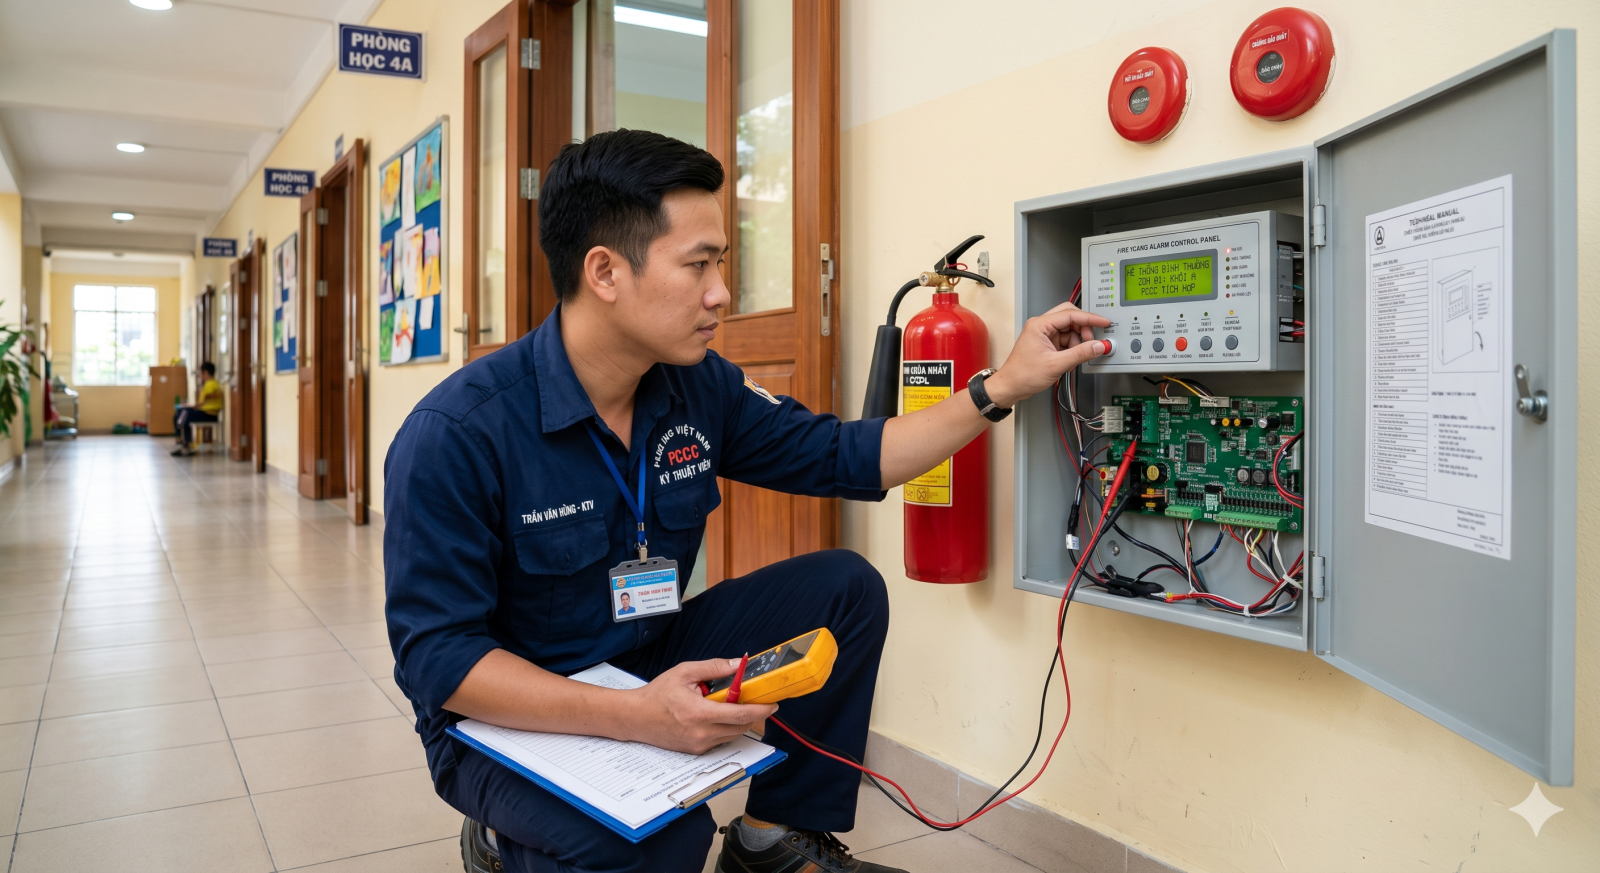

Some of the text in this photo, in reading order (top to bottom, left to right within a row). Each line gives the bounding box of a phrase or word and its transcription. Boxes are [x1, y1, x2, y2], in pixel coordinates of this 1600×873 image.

[351, 31, 411, 53] PHÒNG
[349, 51, 413, 72] HỌC 4A
[272, 172, 308, 184] PHÒNG
[1171, 238, 1199, 247] CONTROL
[928, 364, 948, 375] NHÁY
[675, 424, 695, 437] VIỆT
[695, 431, 711, 451] NAM
[668, 444, 699, 466] PCCC
[672, 465, 696, 479] THUẬT
[544, 508, 558, 520] VĂN
[581, 500, 594, 512] KTV
